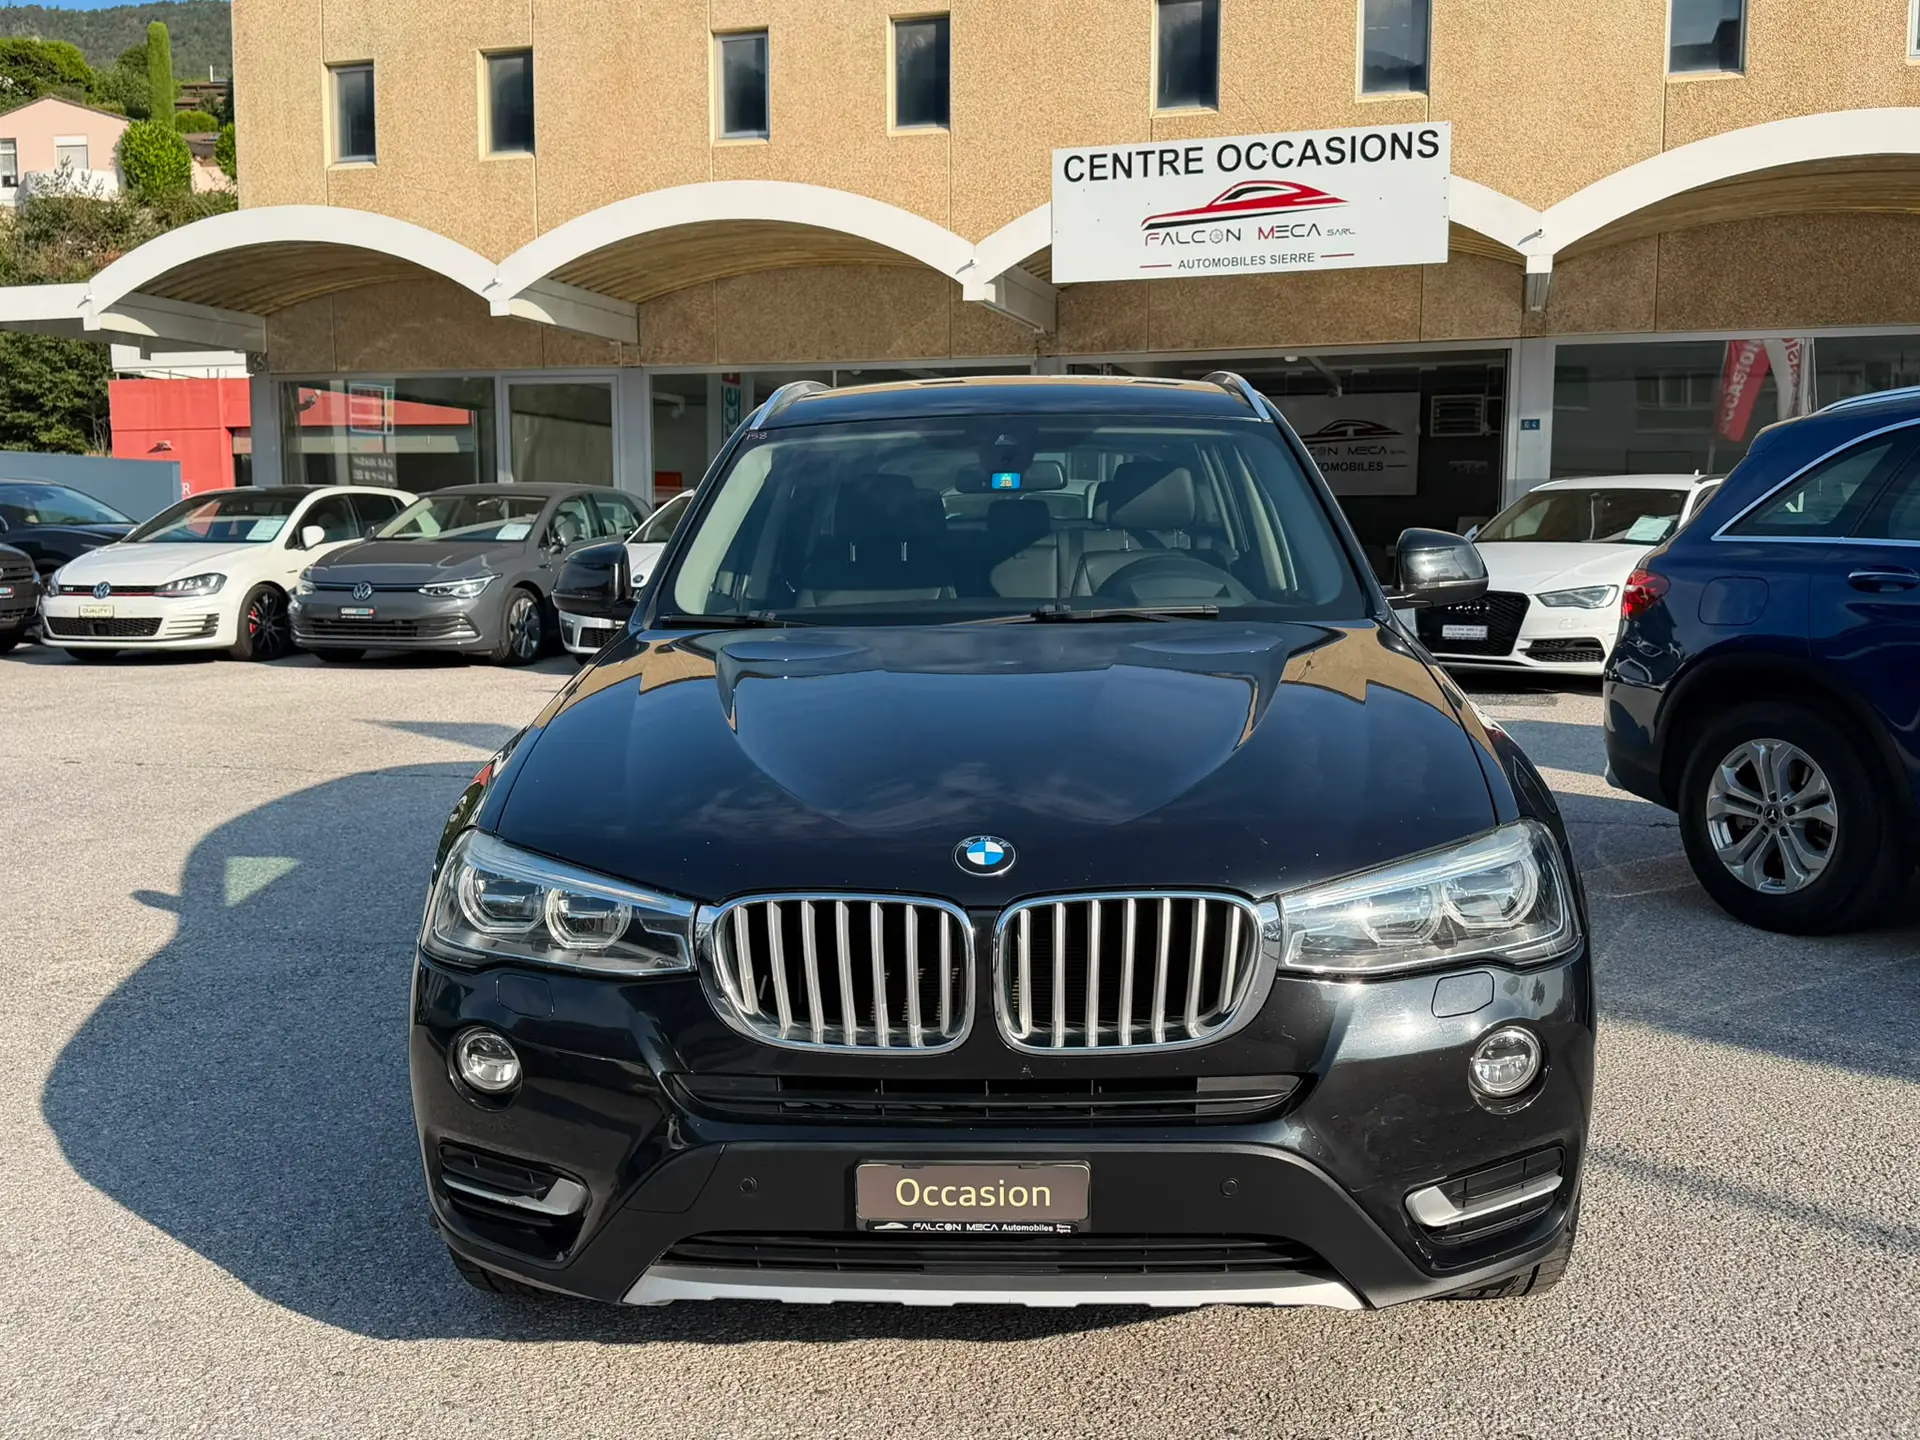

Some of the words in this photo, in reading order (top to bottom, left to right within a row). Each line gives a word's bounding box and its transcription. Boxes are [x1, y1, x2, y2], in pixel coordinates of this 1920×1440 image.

[1063, 146, 1204, 182] CENTRE
[1216, 129, 1440, 172] OCCASIONS
[1144, 227, 1241, 246] FALCON
[1258, 223, 1321, 240] MECA
[1177, 255, 1266, 270] AUTOMOBILES
[1269, 252, 1315, 265] SIERRE
[895, 1178, 1051, 1207] Occasion
[912, 1223, 962, 1232] FALCON
[966, 1223, 999, 1232] MECA
[1001, 1223, 1054, 1232] Automobiles
